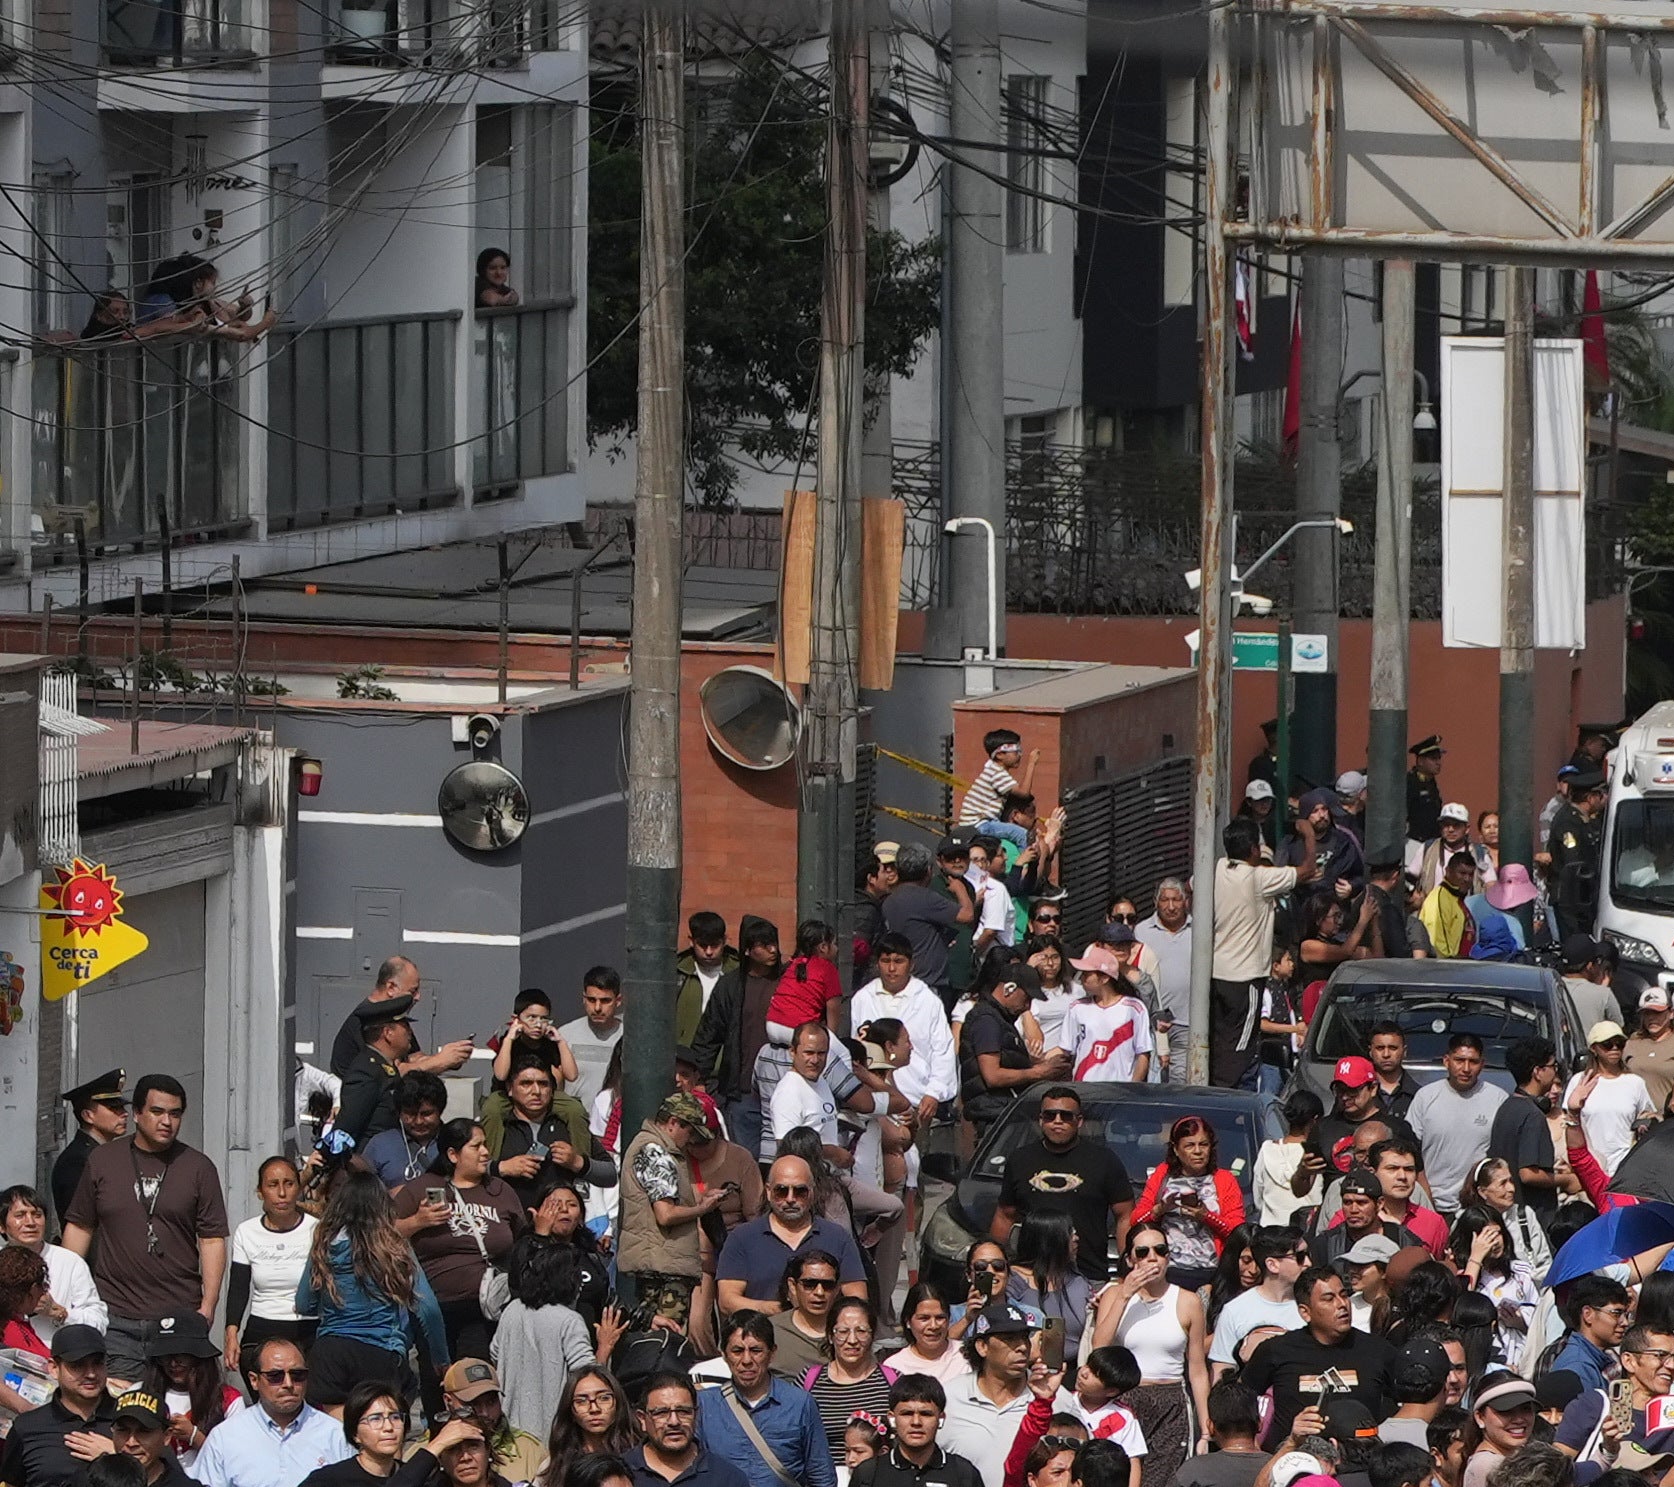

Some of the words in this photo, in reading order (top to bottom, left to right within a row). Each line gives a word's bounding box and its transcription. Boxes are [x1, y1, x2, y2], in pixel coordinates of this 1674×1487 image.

[49, 946, 99, 960] Cerca
[57, 959, 73, 971] de
[73, 961, 92, 980] ti
[116, 1391, 159, 1414] POLICIA
